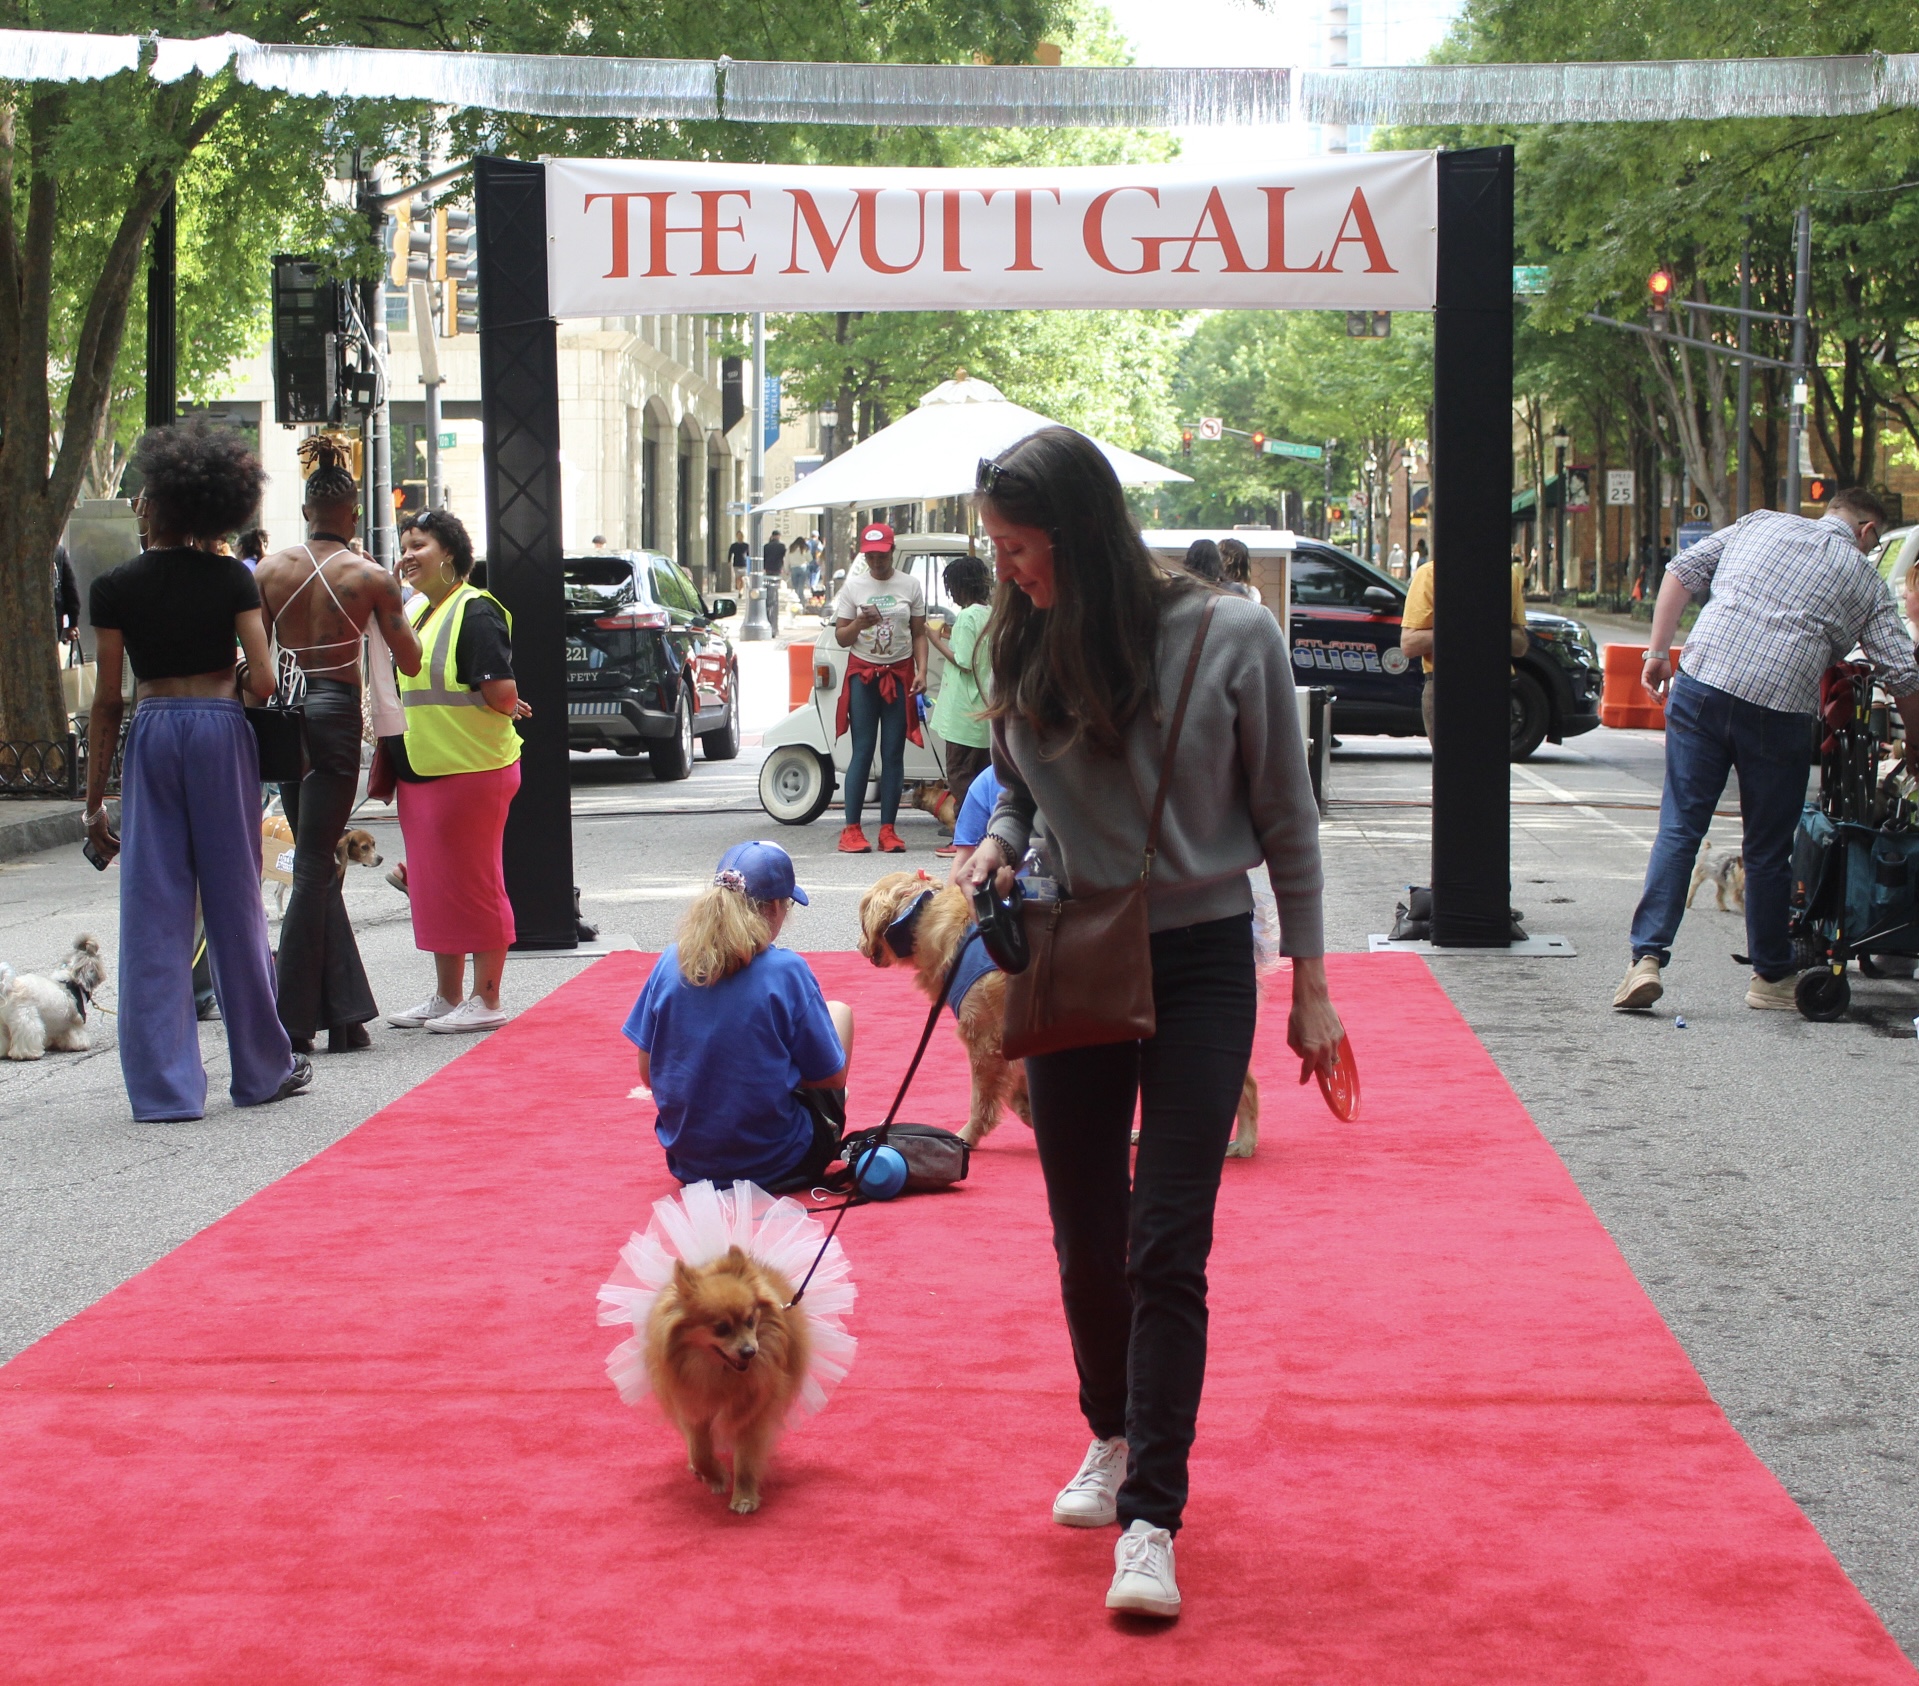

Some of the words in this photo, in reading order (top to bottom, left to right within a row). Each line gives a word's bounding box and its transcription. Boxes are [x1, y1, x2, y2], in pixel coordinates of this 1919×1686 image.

[584, 190, 757, 279] THE
[779, 187, 1061, 275] MUTT
[1083, 186, 1399, 275] GALA
[1611, 488, 1631, 501] 25
[1295, 638, 1378, 652] ATLANTA
[1291, 647, 1383, 673] OLICE
